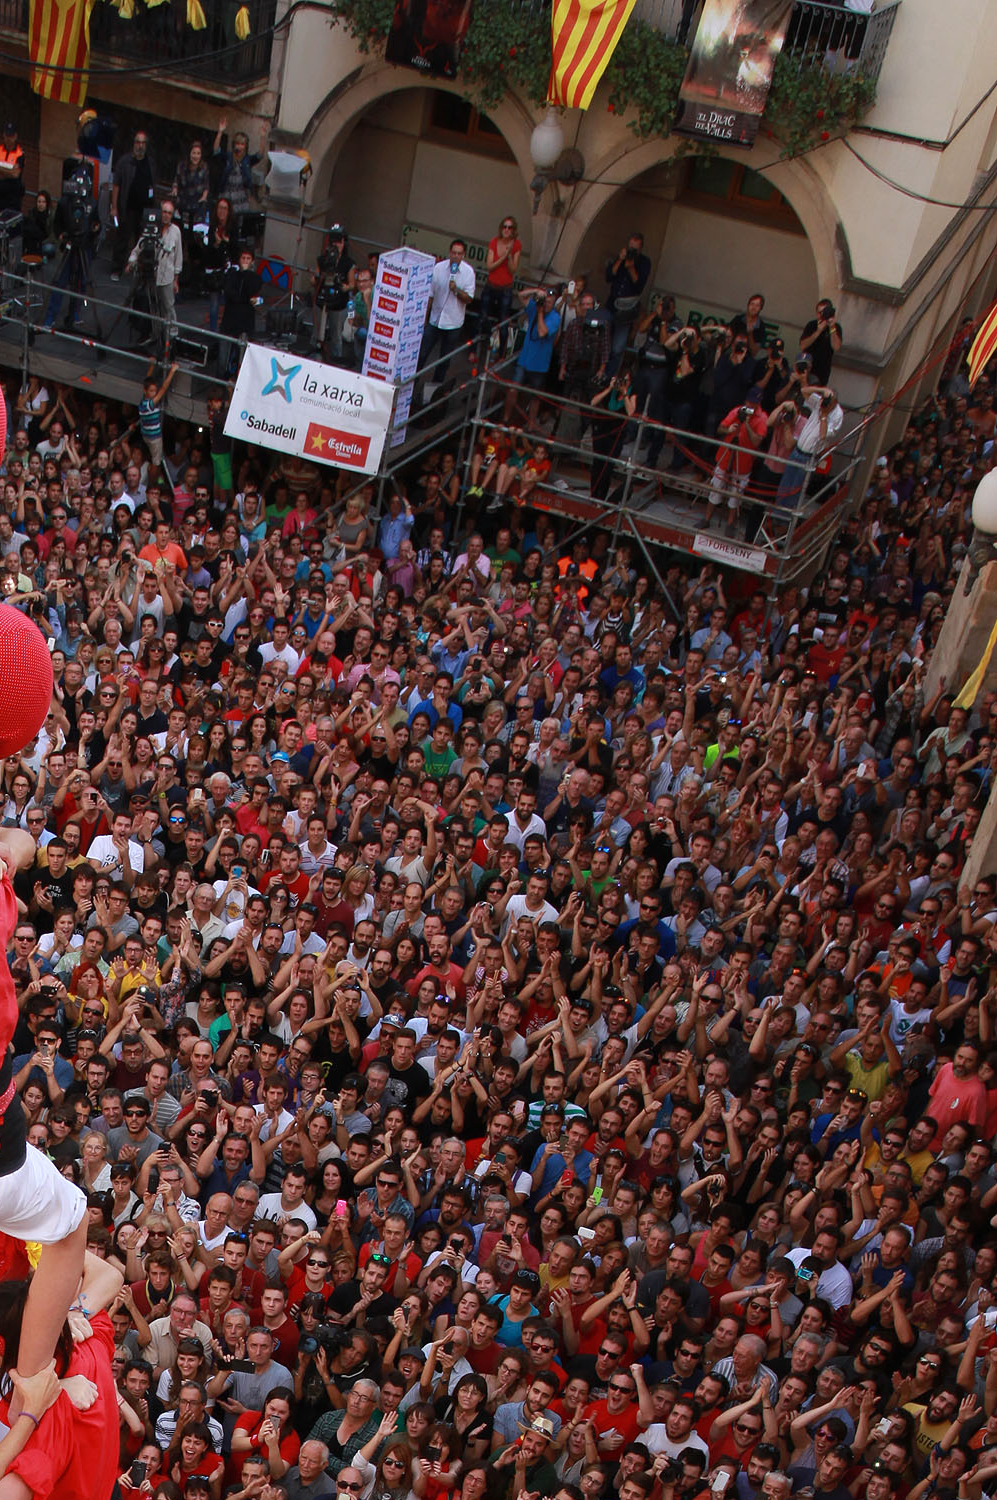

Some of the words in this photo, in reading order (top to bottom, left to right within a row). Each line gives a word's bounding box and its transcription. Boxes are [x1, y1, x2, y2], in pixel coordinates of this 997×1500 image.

[383, 261, 408, 275] Sabadell
[379, 287, 404, 301] Sabadell
[375, 312, 400, 326] Sabadell
[303, 373, 318, 394] la
[320, 383, 364, 408] xarxa
[300, 395, 342, 414] comunicació
[343, 406, 361, 418] local
[246, 415, 297, 441] Sabadell
[328, 437, 362, 456] Estrella
